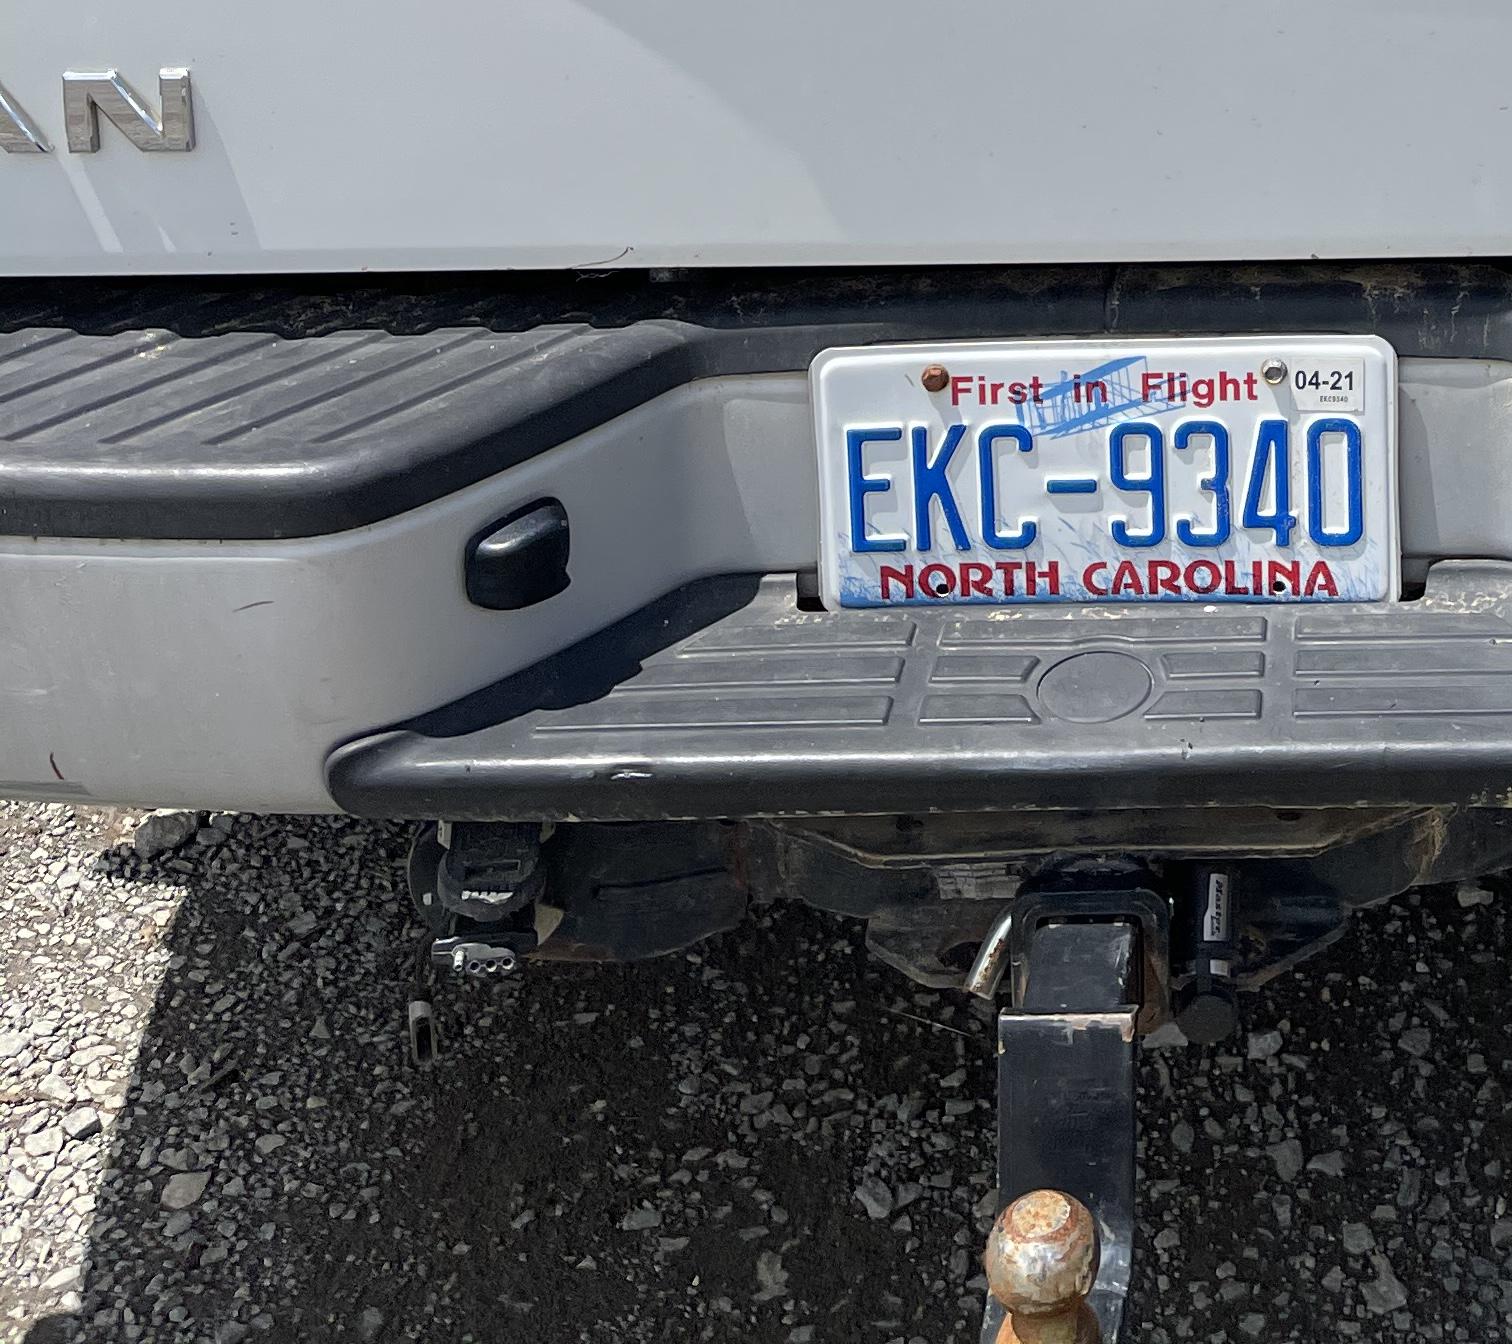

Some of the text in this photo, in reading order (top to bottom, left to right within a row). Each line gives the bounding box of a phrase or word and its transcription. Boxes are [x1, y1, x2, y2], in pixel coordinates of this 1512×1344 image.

[951, 370, 1259, 409] First in Flight
[1294, 369, 1355, 391] 04-21
[846, 418, 1363, 553] EKC-9340
[881, 560, 1339, 600] NORTH CAROLINA
